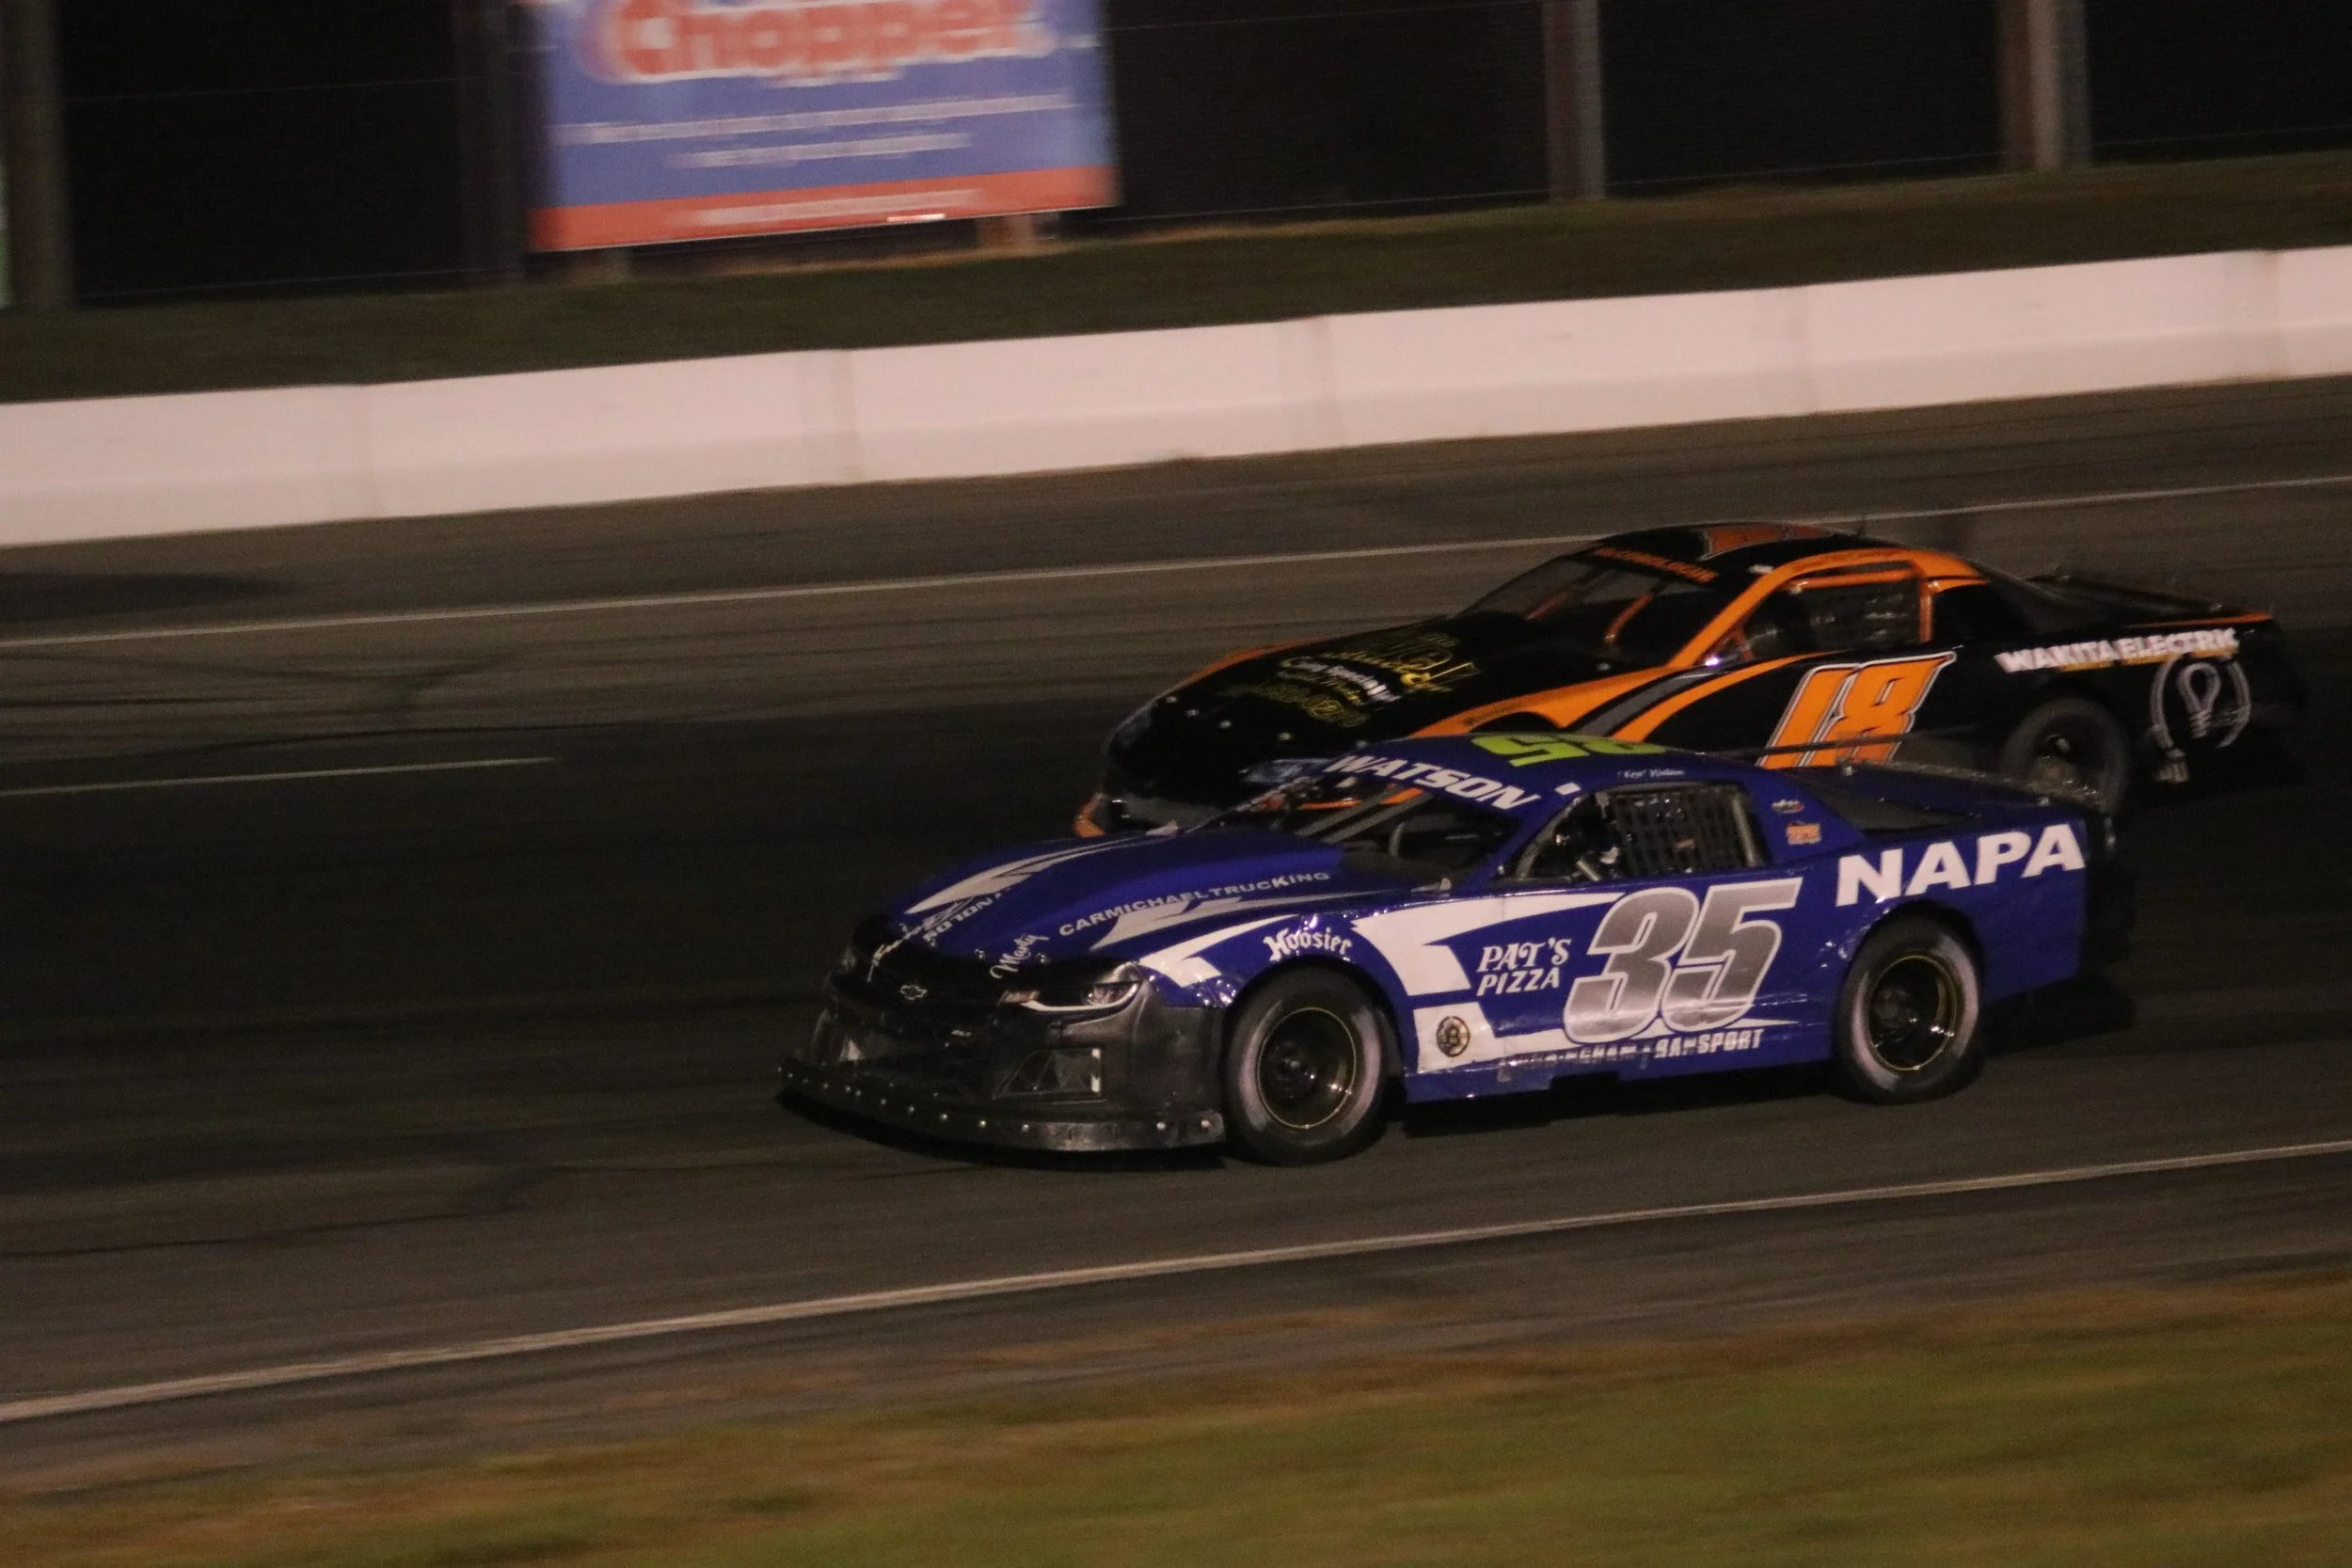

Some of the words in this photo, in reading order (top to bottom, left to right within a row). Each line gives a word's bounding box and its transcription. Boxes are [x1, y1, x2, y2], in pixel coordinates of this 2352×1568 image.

[1757, 652, 1956, 768] 18
[1322, 754, 1542, 810] WATSON
[1835, 823, 2086, 907] NAPA
[1057, 890, 1208, 937] CARMICHAEL
[1207, 872, 1330, 897] TRUCKING
[1262, 927, 1353, 962] Hoosier
[1475, 938, 1572, 973] PAT'S
[1562, 877, 1804, 1044] 35
[1475, 970, 1560, 997] PIZZA
